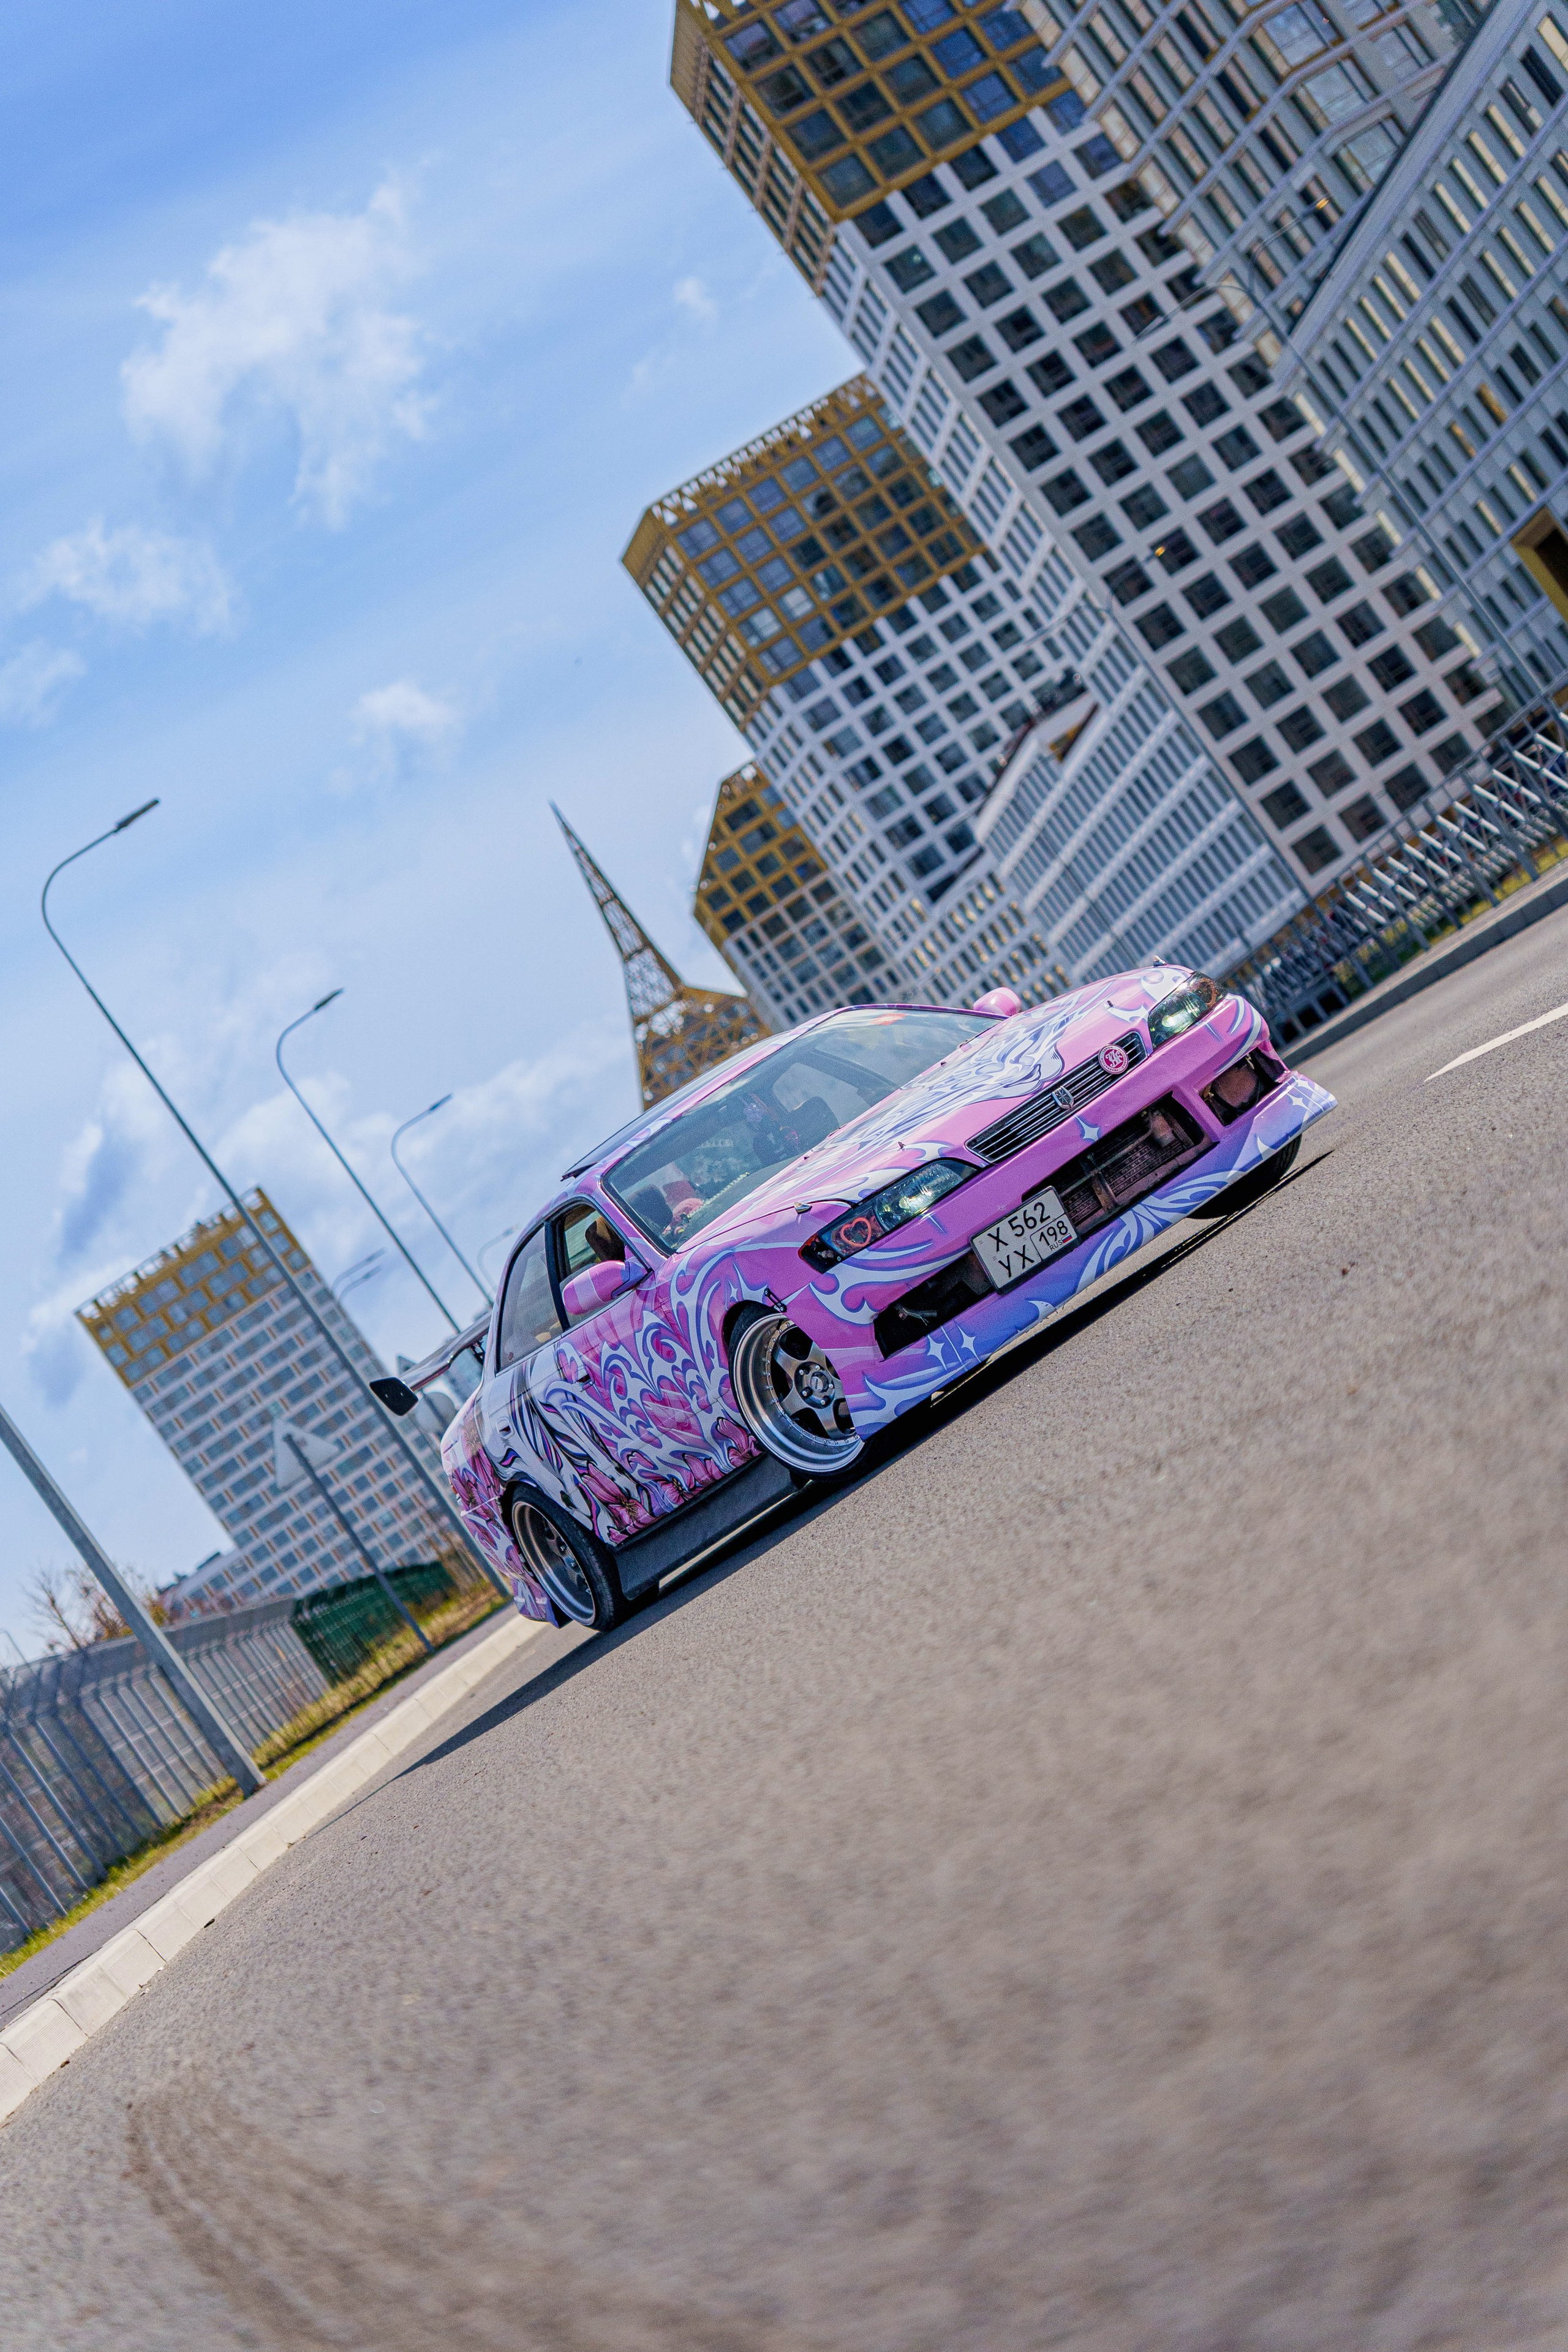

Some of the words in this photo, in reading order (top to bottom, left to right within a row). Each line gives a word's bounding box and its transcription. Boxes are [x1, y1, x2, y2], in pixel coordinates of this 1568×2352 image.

[987, 1227, 1009, 1252] Х
[1008, 1202, 1050, 1237] 562
[1039, 1220, 1068, 1246] 198
[1049, 1240, 1063, 1251] RUS
